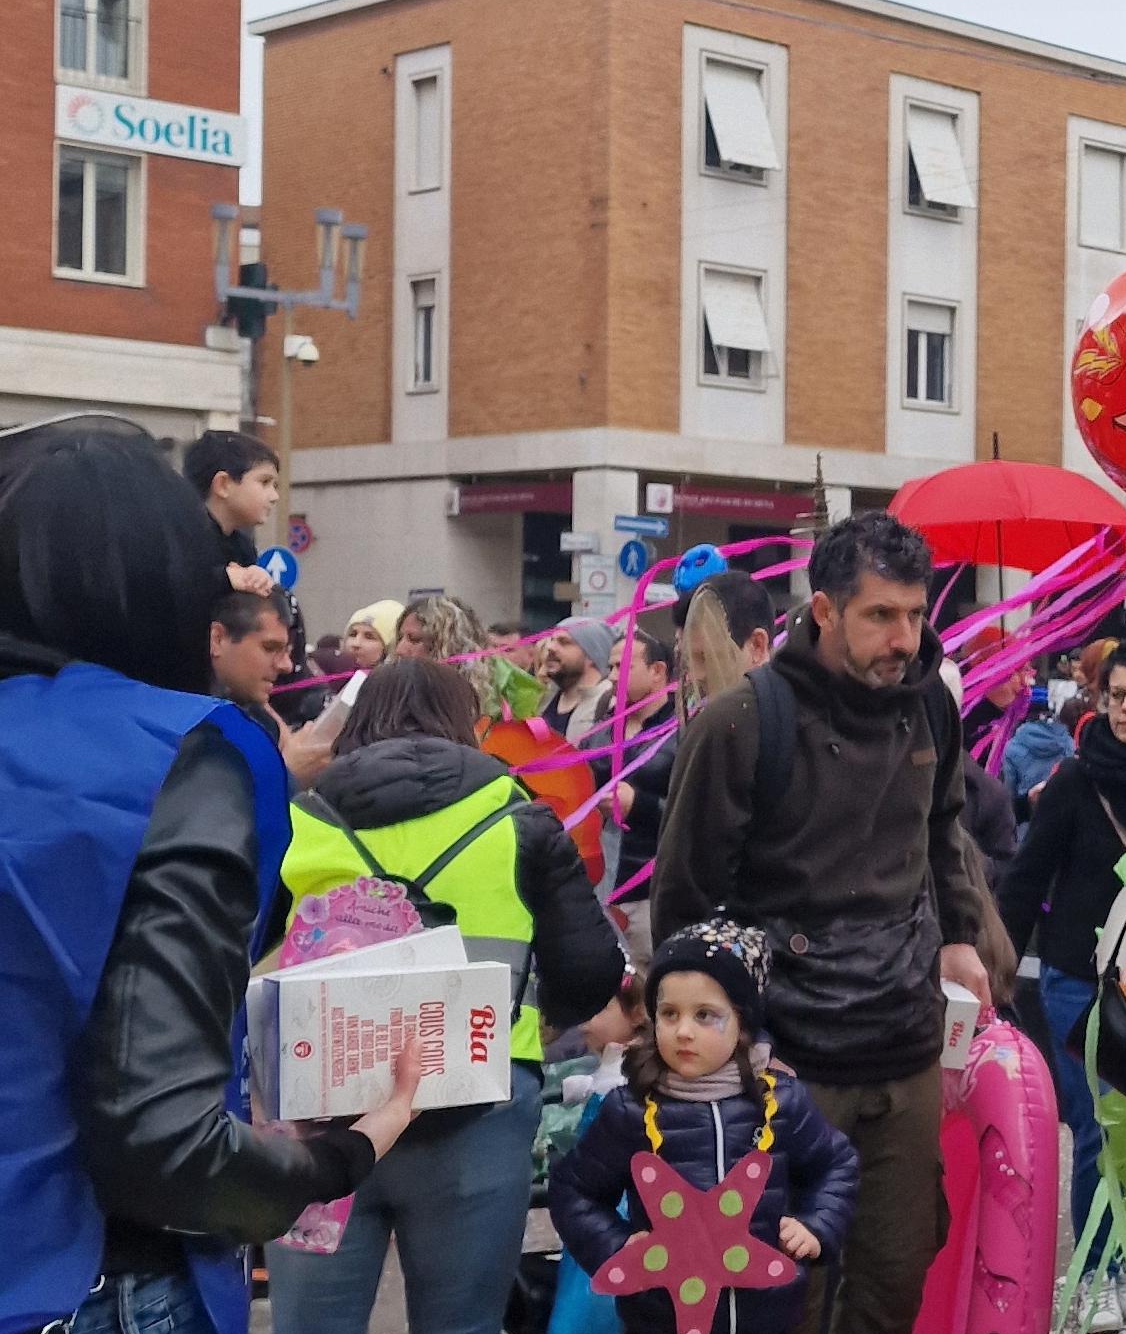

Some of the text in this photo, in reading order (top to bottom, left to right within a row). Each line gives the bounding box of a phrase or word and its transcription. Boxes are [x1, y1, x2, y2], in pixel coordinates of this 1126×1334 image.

[114, 105, 232, 156] Soelia
[419, 1001, 445, 1037] COUS
[469, 1005, 496, 1065] Bia
